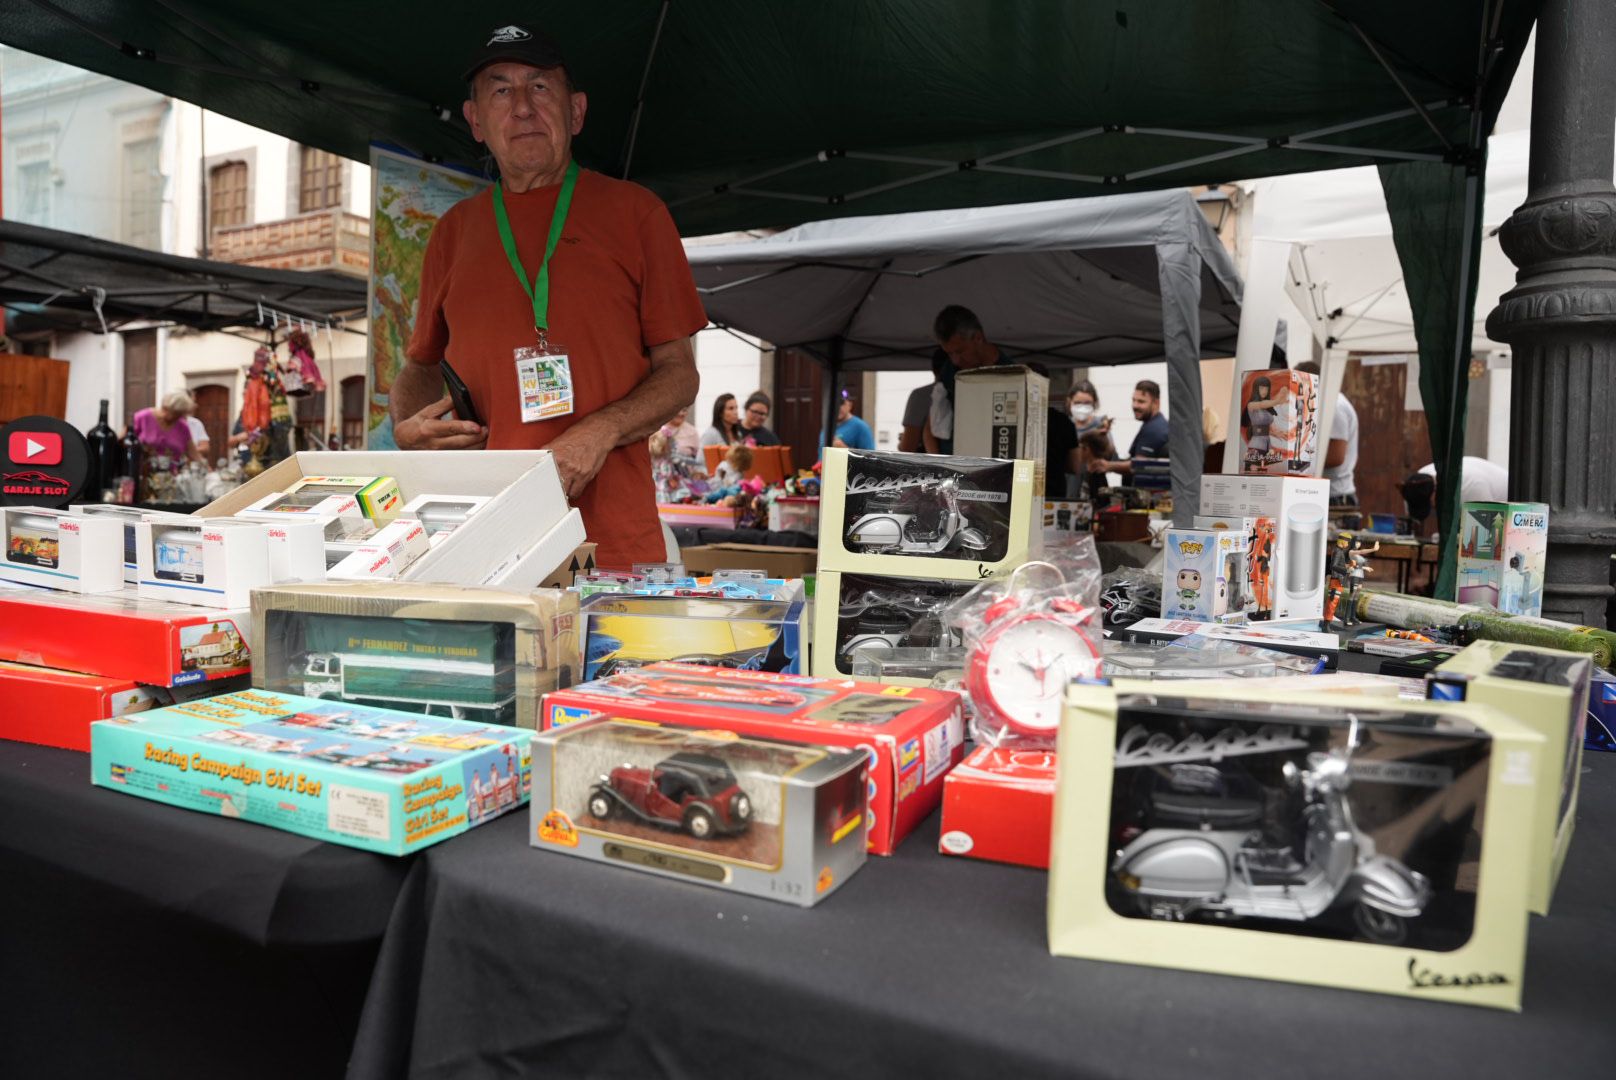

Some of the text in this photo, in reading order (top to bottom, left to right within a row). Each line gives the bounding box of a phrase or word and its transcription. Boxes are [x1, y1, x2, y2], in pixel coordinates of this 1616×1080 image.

[999, 426, 1009, 459] ZEBO
[3, 485, 68, 496] GARAJE SLOT
[846, 472, 941, 495] Vespa
[59, 522, 80, 531] märklin
[203, 533, 223, 541] märklin
[268, 529, 286, 538] ärklin
[144, 742, 322, 798] Racing Campaign Girl Set
[403, 775, 443, 797] Racing
[403, 783, 463, 814] Campaign
[405, 813, 430, 833] Girl
[431, 807, 449, 824] Set
[1407, 957, 1509, 988] Vespa
